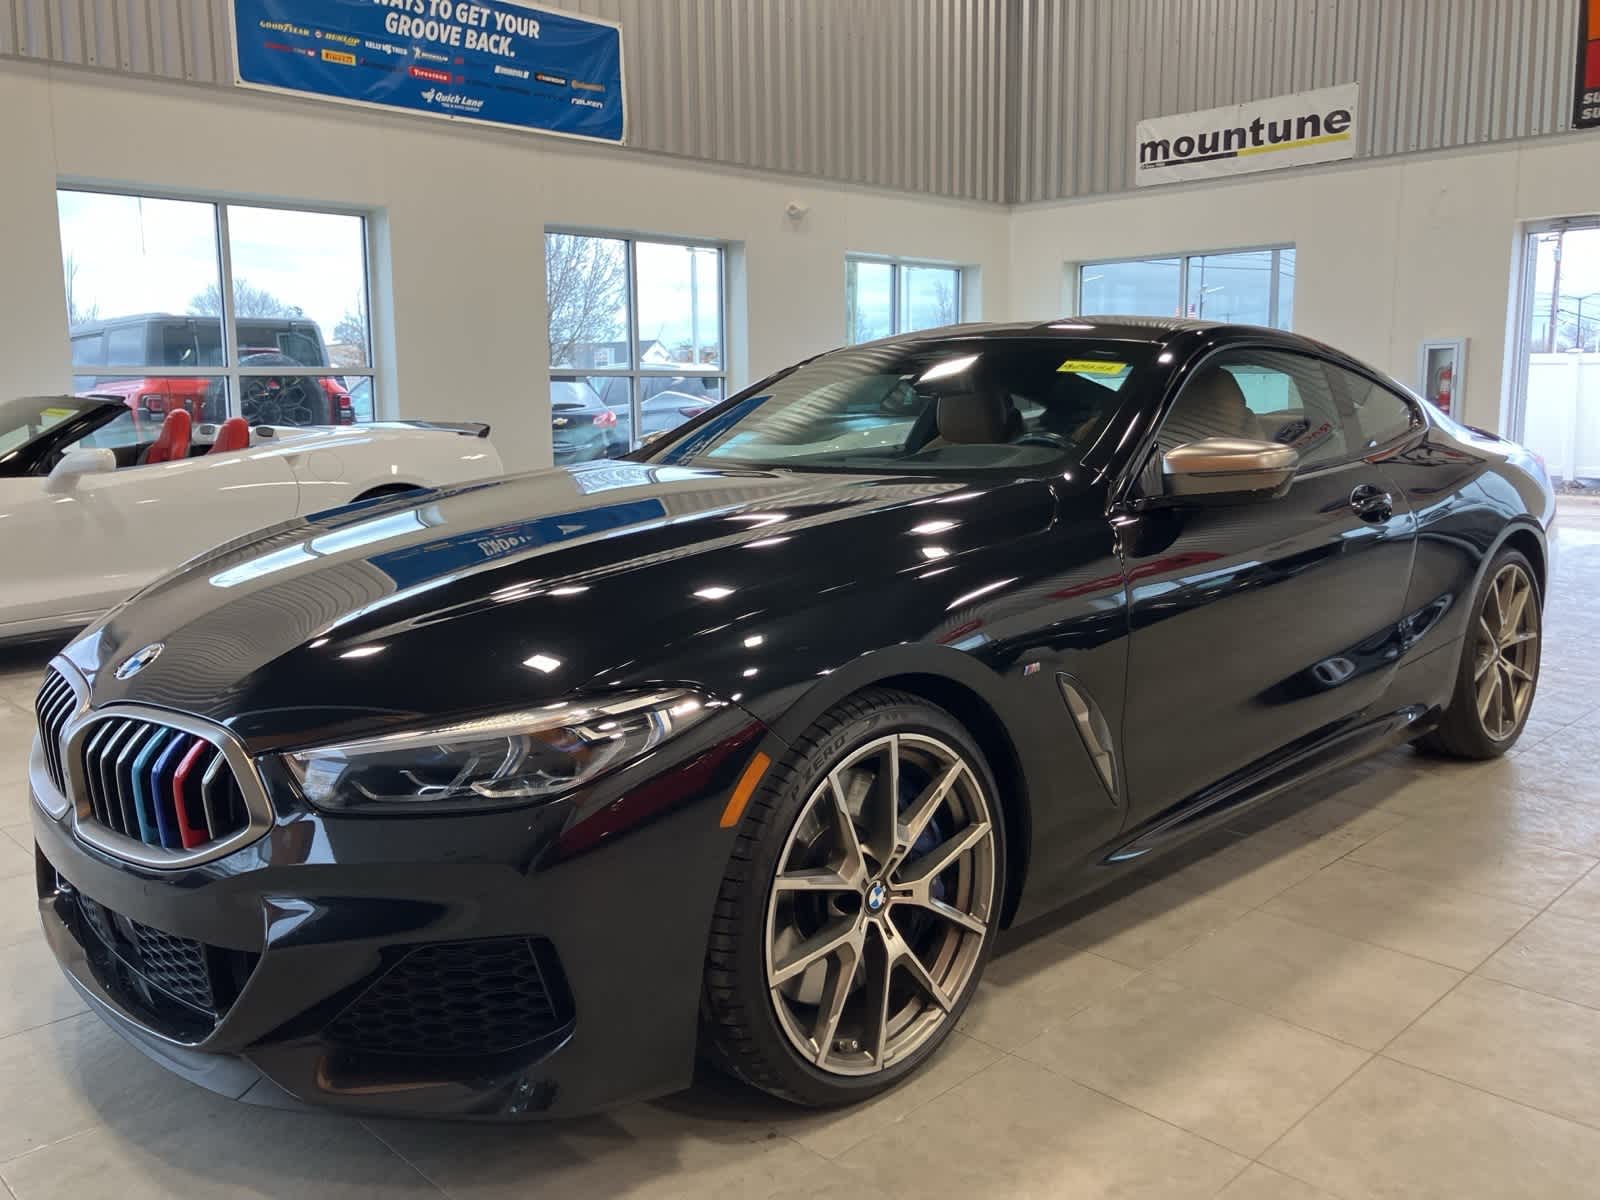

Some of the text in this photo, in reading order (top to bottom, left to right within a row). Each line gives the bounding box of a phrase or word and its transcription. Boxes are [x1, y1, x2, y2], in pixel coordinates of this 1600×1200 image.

[259, 20, 310, 36] GOODYEAR
[372, 0, 540, 39] YS TO GET YOUR
[385, 12, 516, 57] GROOVE BACK.
[435, 91, 461, 105] Quick
[461, 96, 485, 107] Lane
[1140, 109, 1352, 164] mountune
